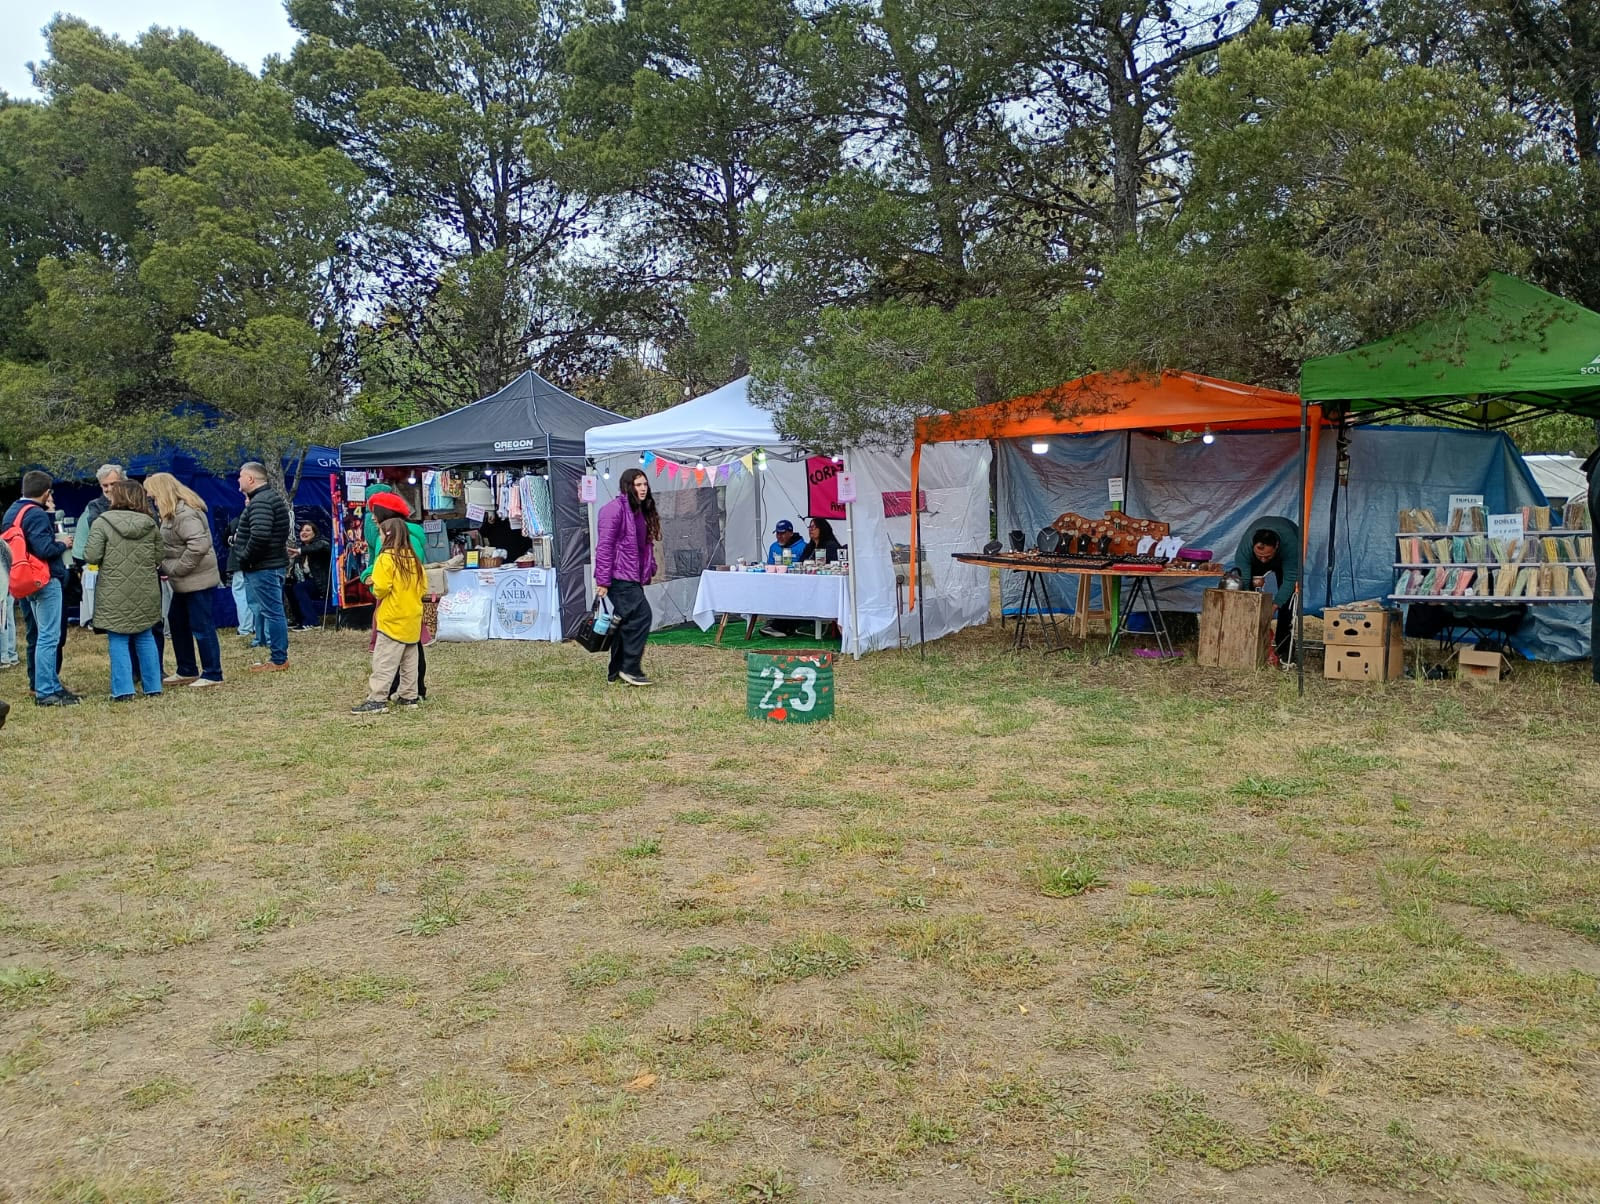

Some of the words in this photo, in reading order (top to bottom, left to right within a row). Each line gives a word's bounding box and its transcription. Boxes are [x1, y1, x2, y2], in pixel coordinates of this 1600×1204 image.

[494, 439, 534, 449] OREGON
[1455, 496, 1477, 504] TRIPLES
[1493, 518, 1517, 526] DOBLES
[498, 589, 532, 600] ANEBA
[758, 665, 817, 712] 23
